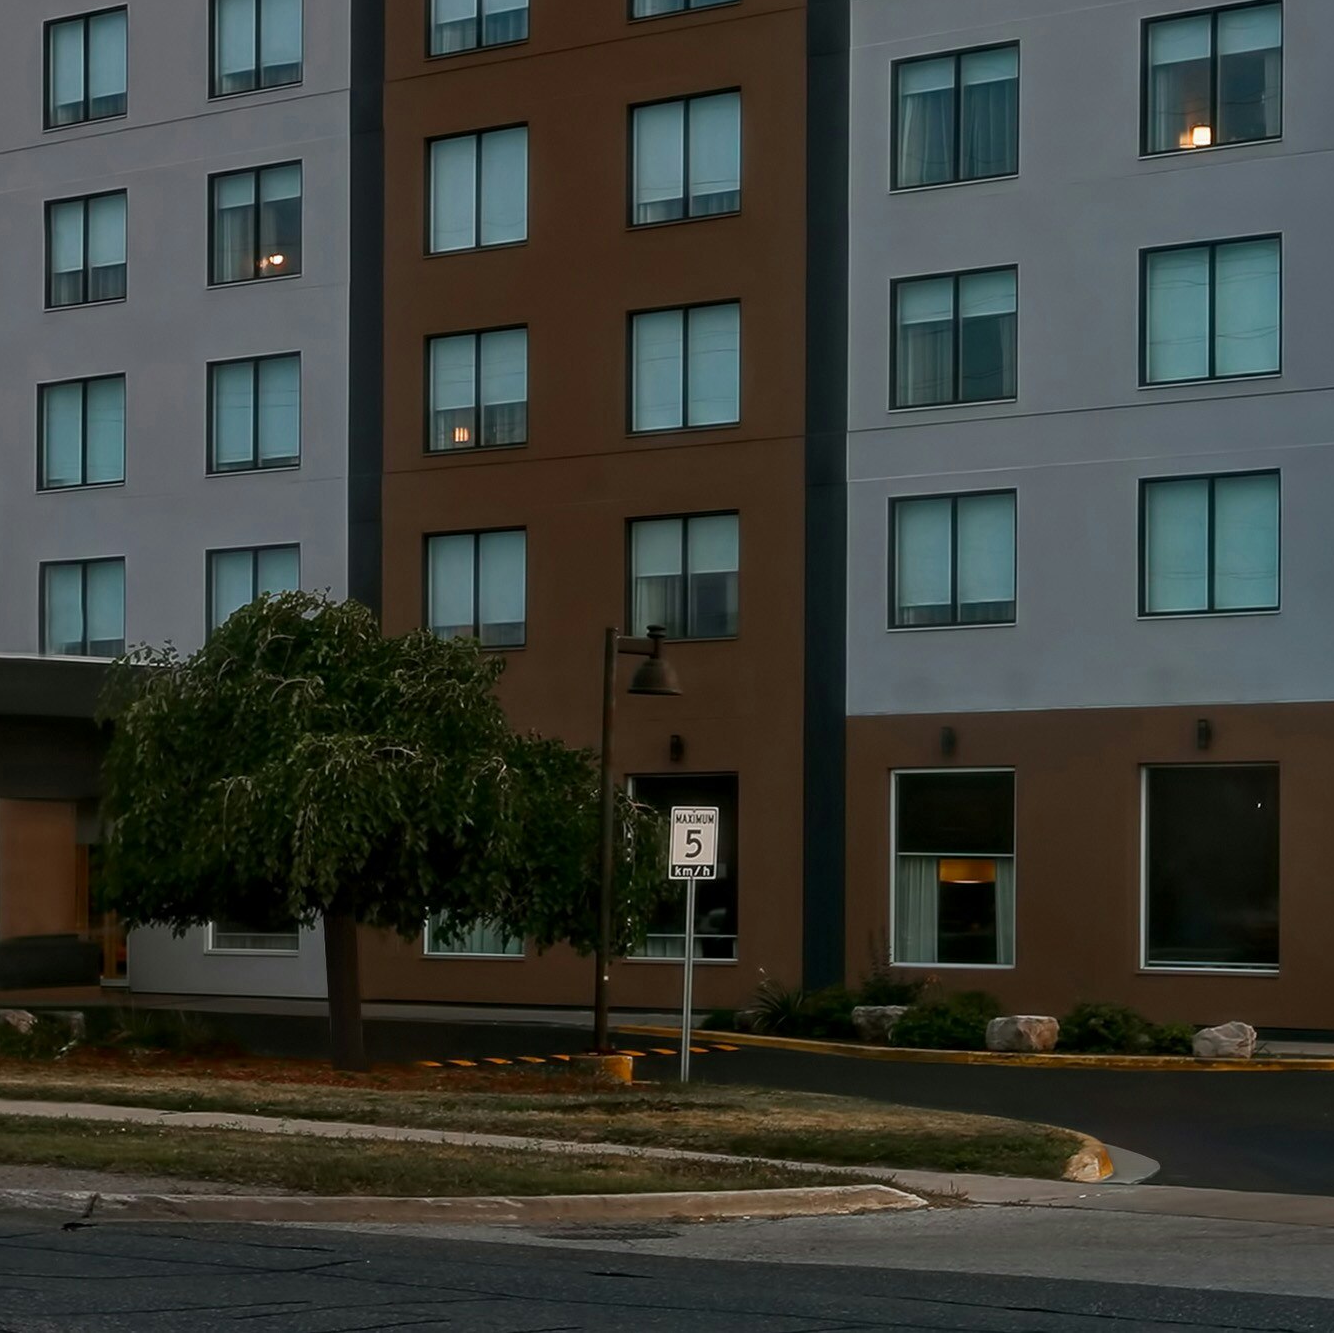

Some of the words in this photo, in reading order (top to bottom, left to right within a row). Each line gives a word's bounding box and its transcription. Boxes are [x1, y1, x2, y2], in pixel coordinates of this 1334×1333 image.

[675, 814, 714, 824] MAXIMUM
[685, 829, 702, 858] 5
[675, 866, 710, 876] km/h
